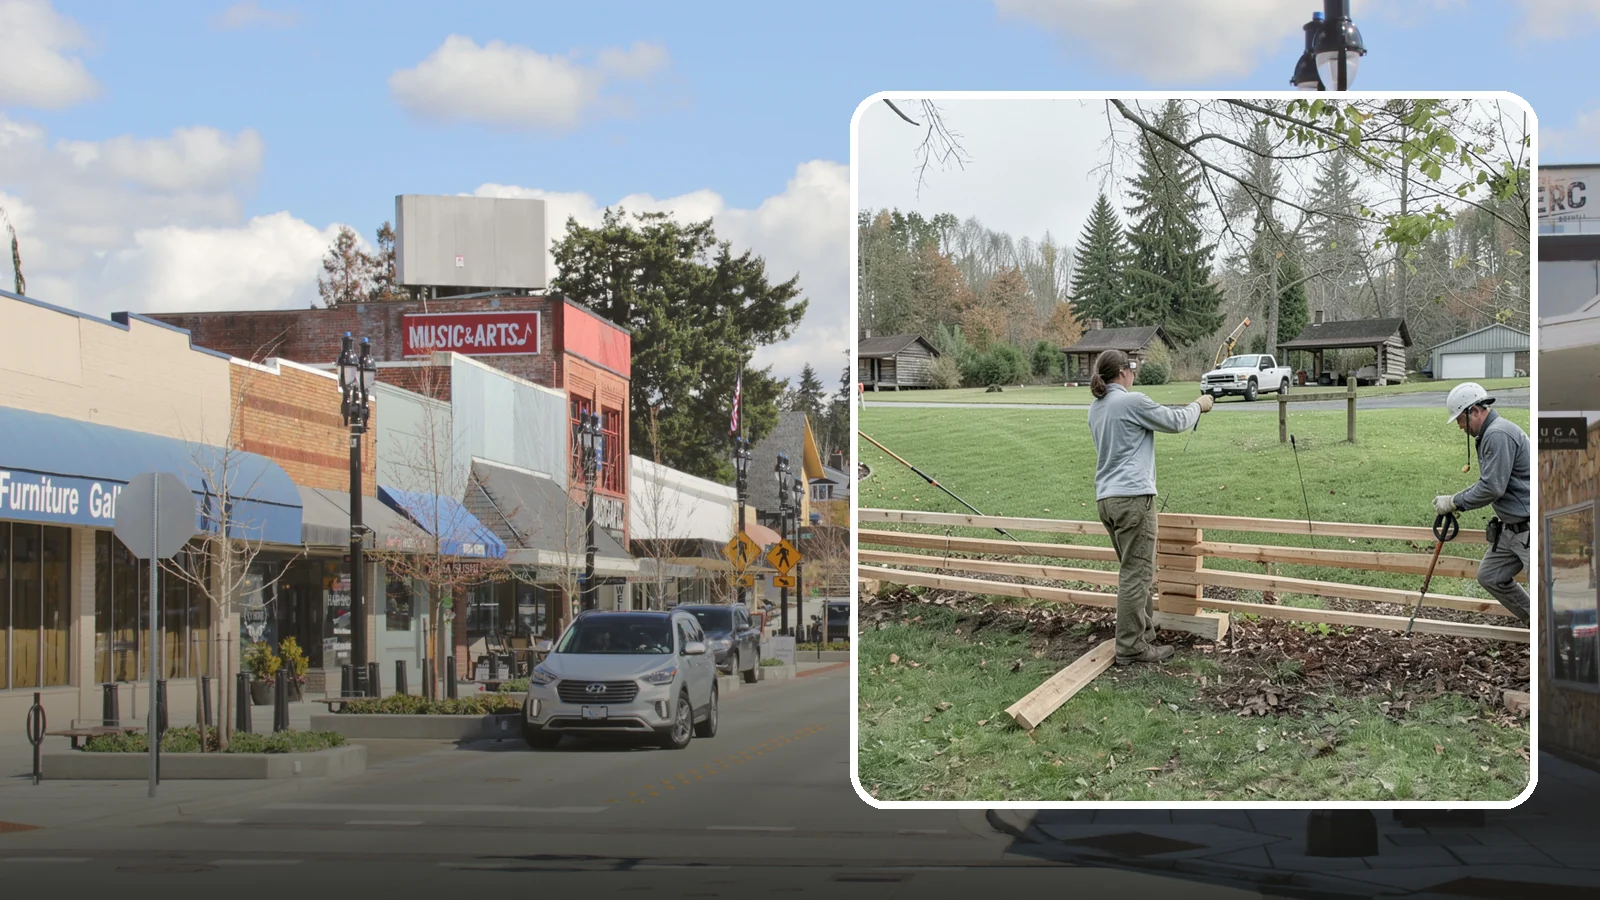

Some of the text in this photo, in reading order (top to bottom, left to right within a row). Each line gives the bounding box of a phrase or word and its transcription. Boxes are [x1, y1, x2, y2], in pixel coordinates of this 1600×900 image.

[1540, 427, 1578, 437] UGA
[0, 471, 122, 519] Furniture Gal
[453, 563, 480, 574] SUSHI
